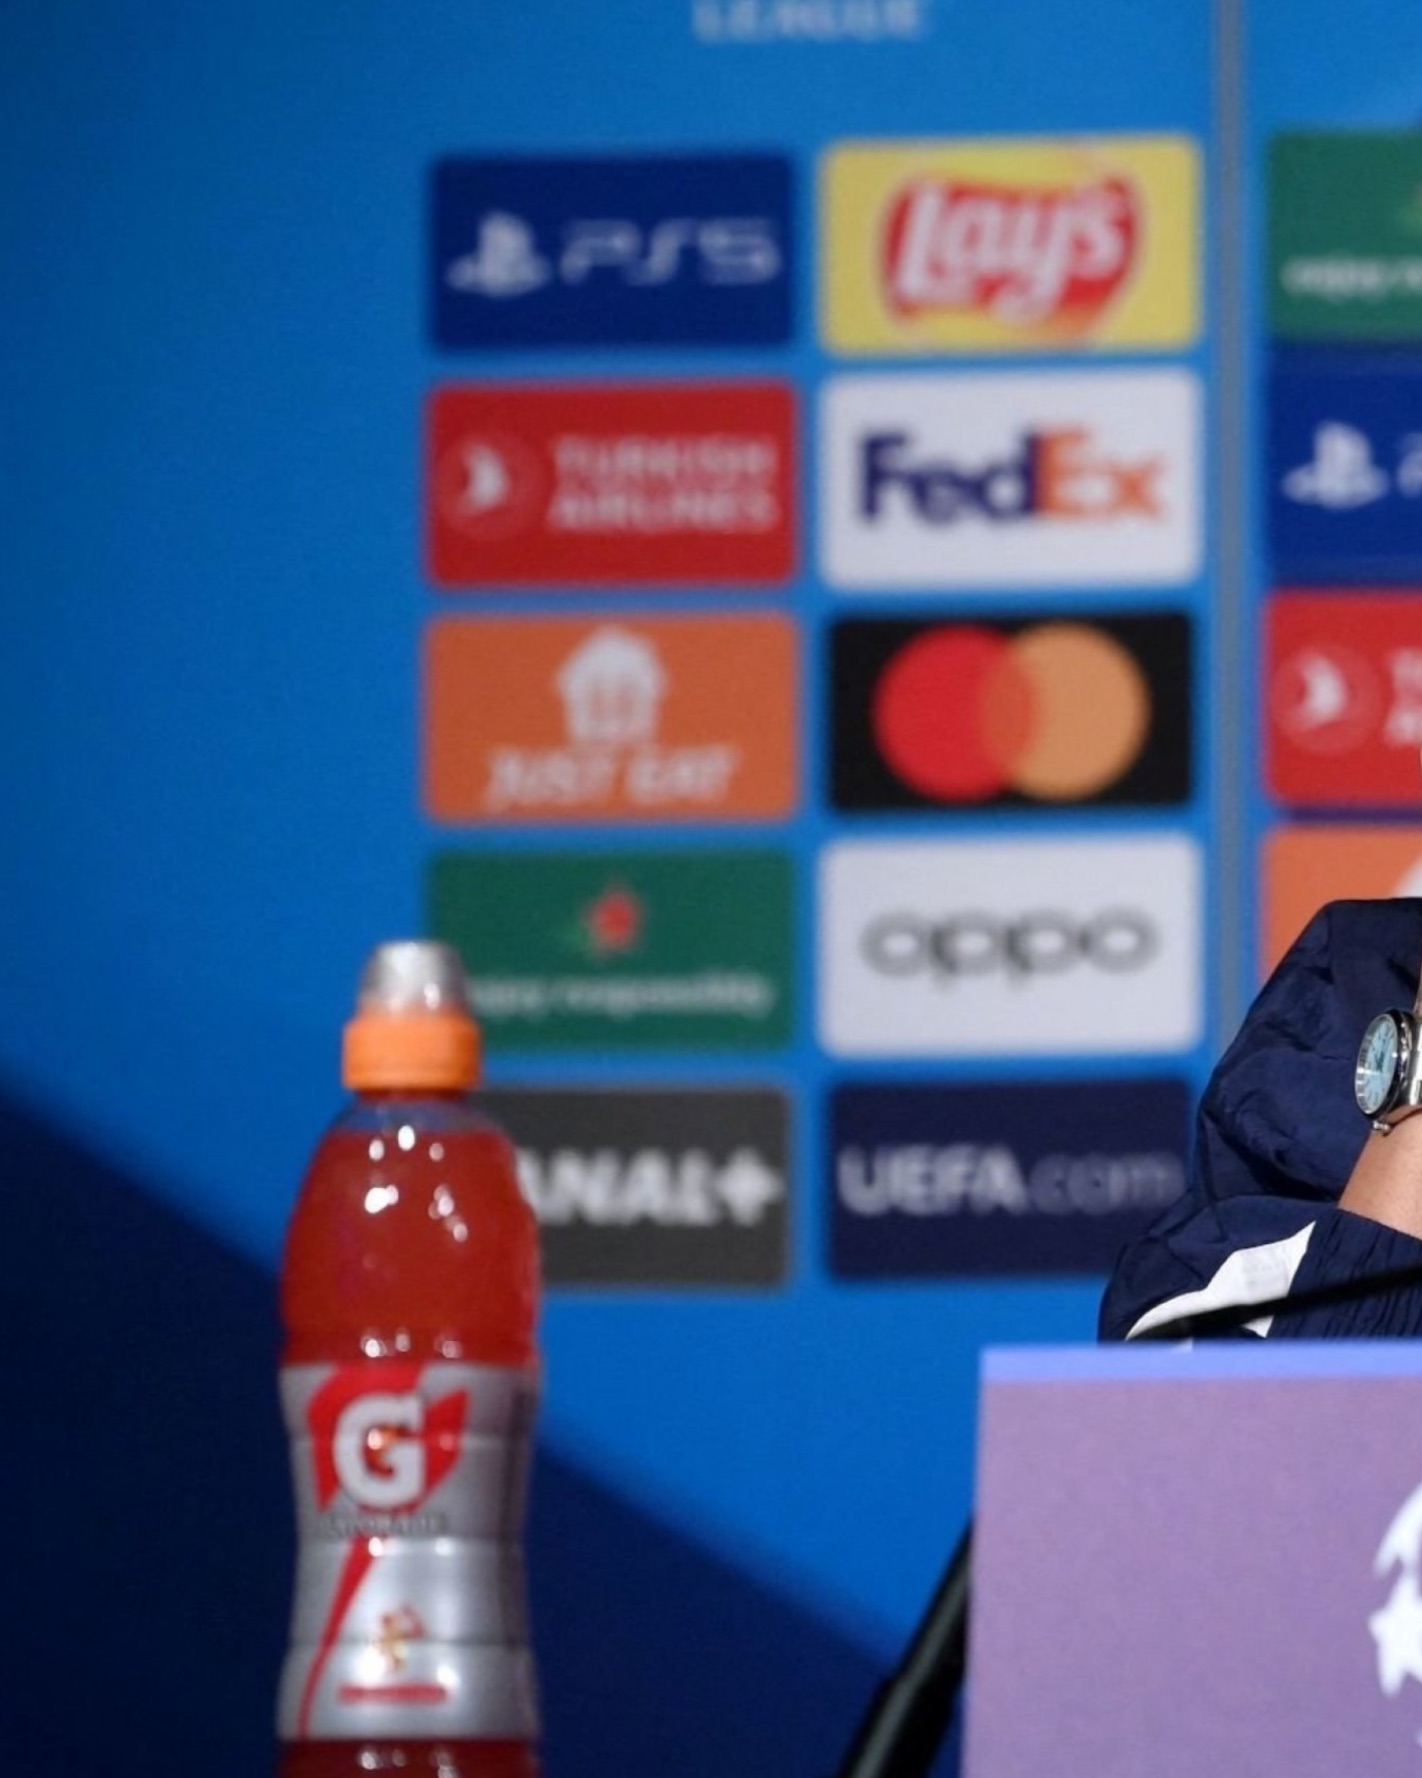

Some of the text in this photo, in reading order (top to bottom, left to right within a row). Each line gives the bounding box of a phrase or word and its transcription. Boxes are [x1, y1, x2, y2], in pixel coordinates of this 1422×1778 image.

[559, 218, 782, 286] PS5
[858, 427, 1167, 529] FedEx
[861, 908, 1157, 988] oppo
[515, 1146, 782, 1228] ANAL+
[332, 1390, 427, 1508] G
